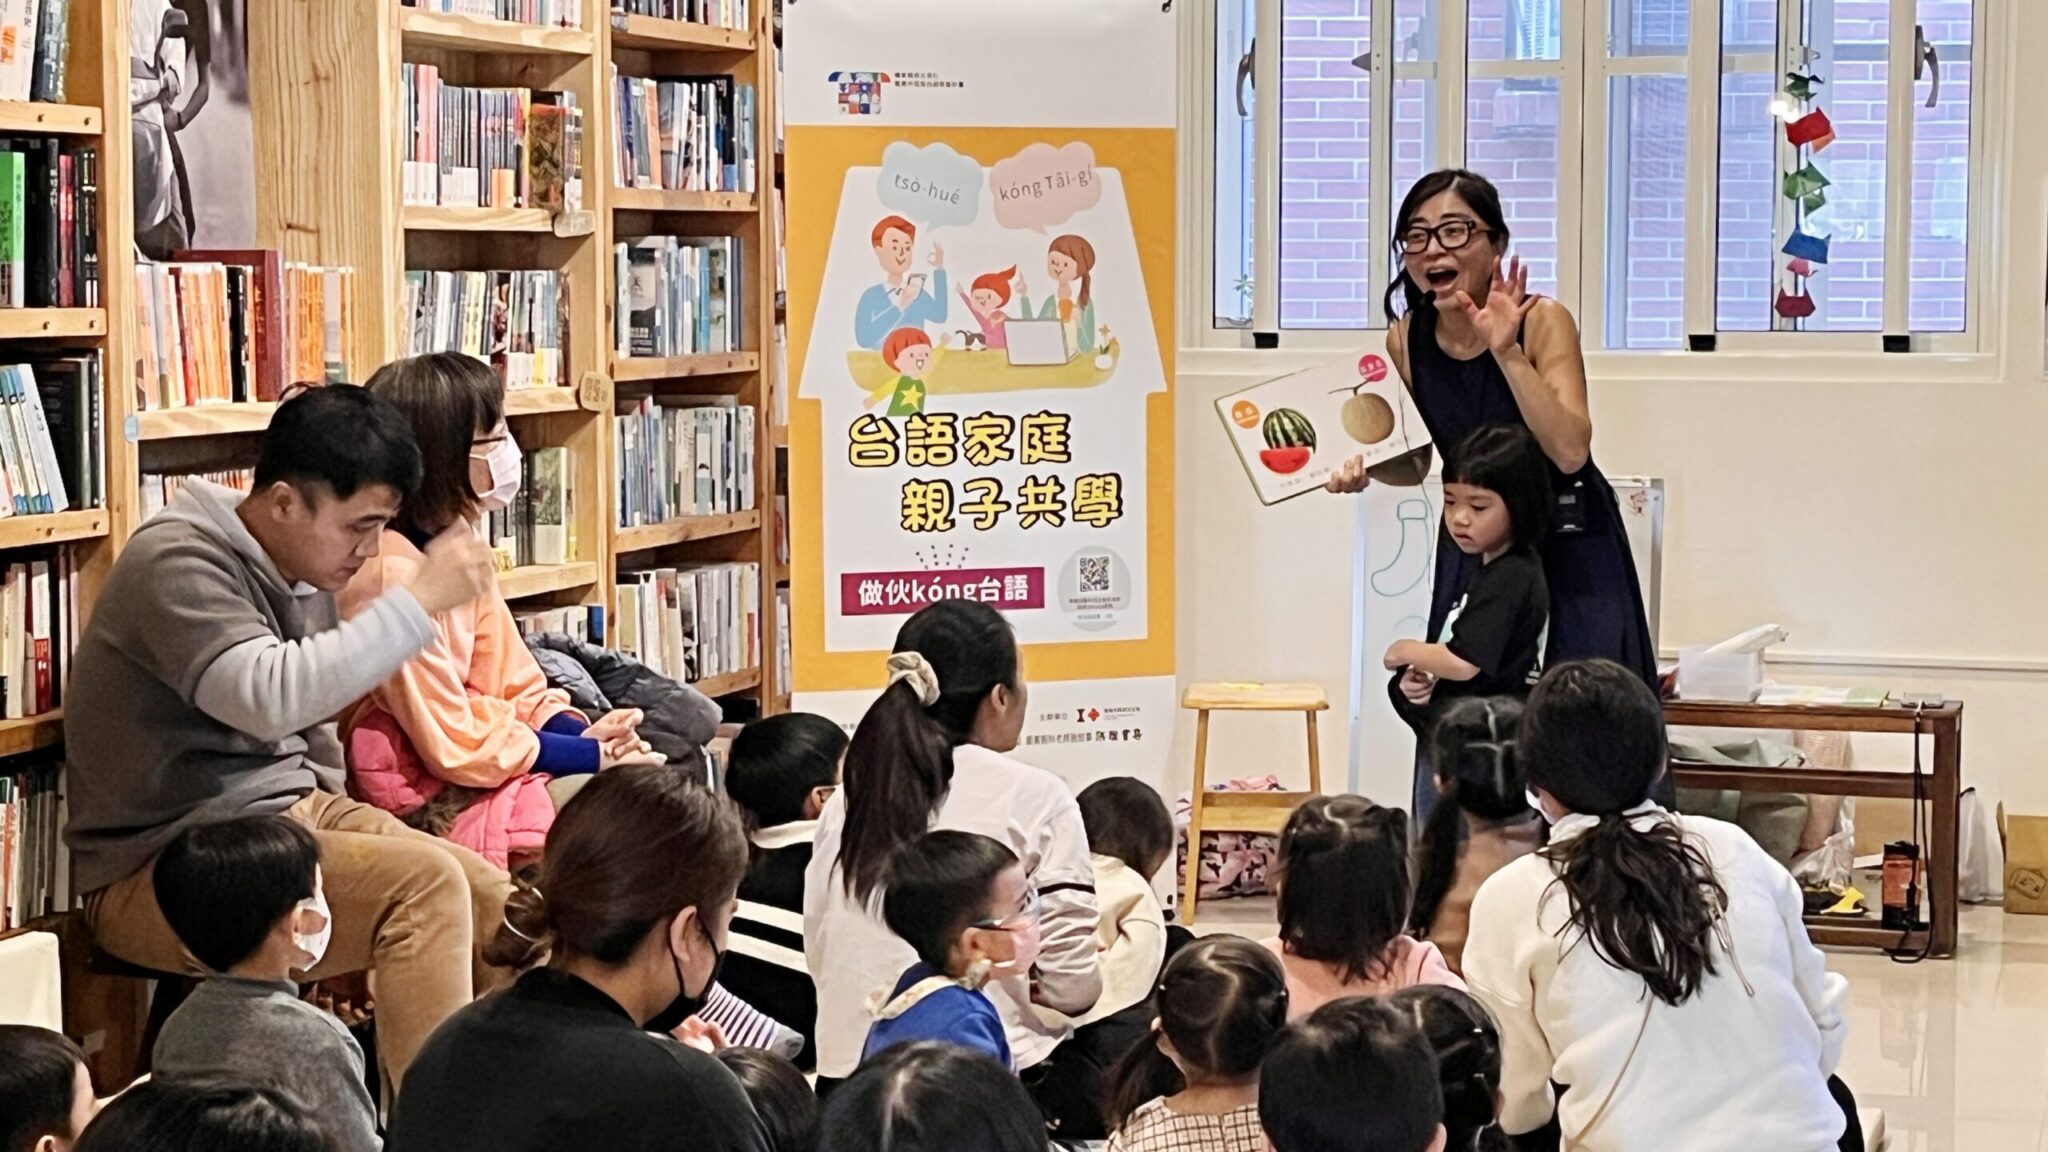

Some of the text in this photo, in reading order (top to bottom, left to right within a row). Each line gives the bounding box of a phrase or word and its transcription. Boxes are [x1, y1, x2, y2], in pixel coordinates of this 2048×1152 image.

[1000, 181, 1042, 200] kóng
[849, 410, 1071, 467] 台語家庭
[901, 473, 1123, 532] 親子共學
